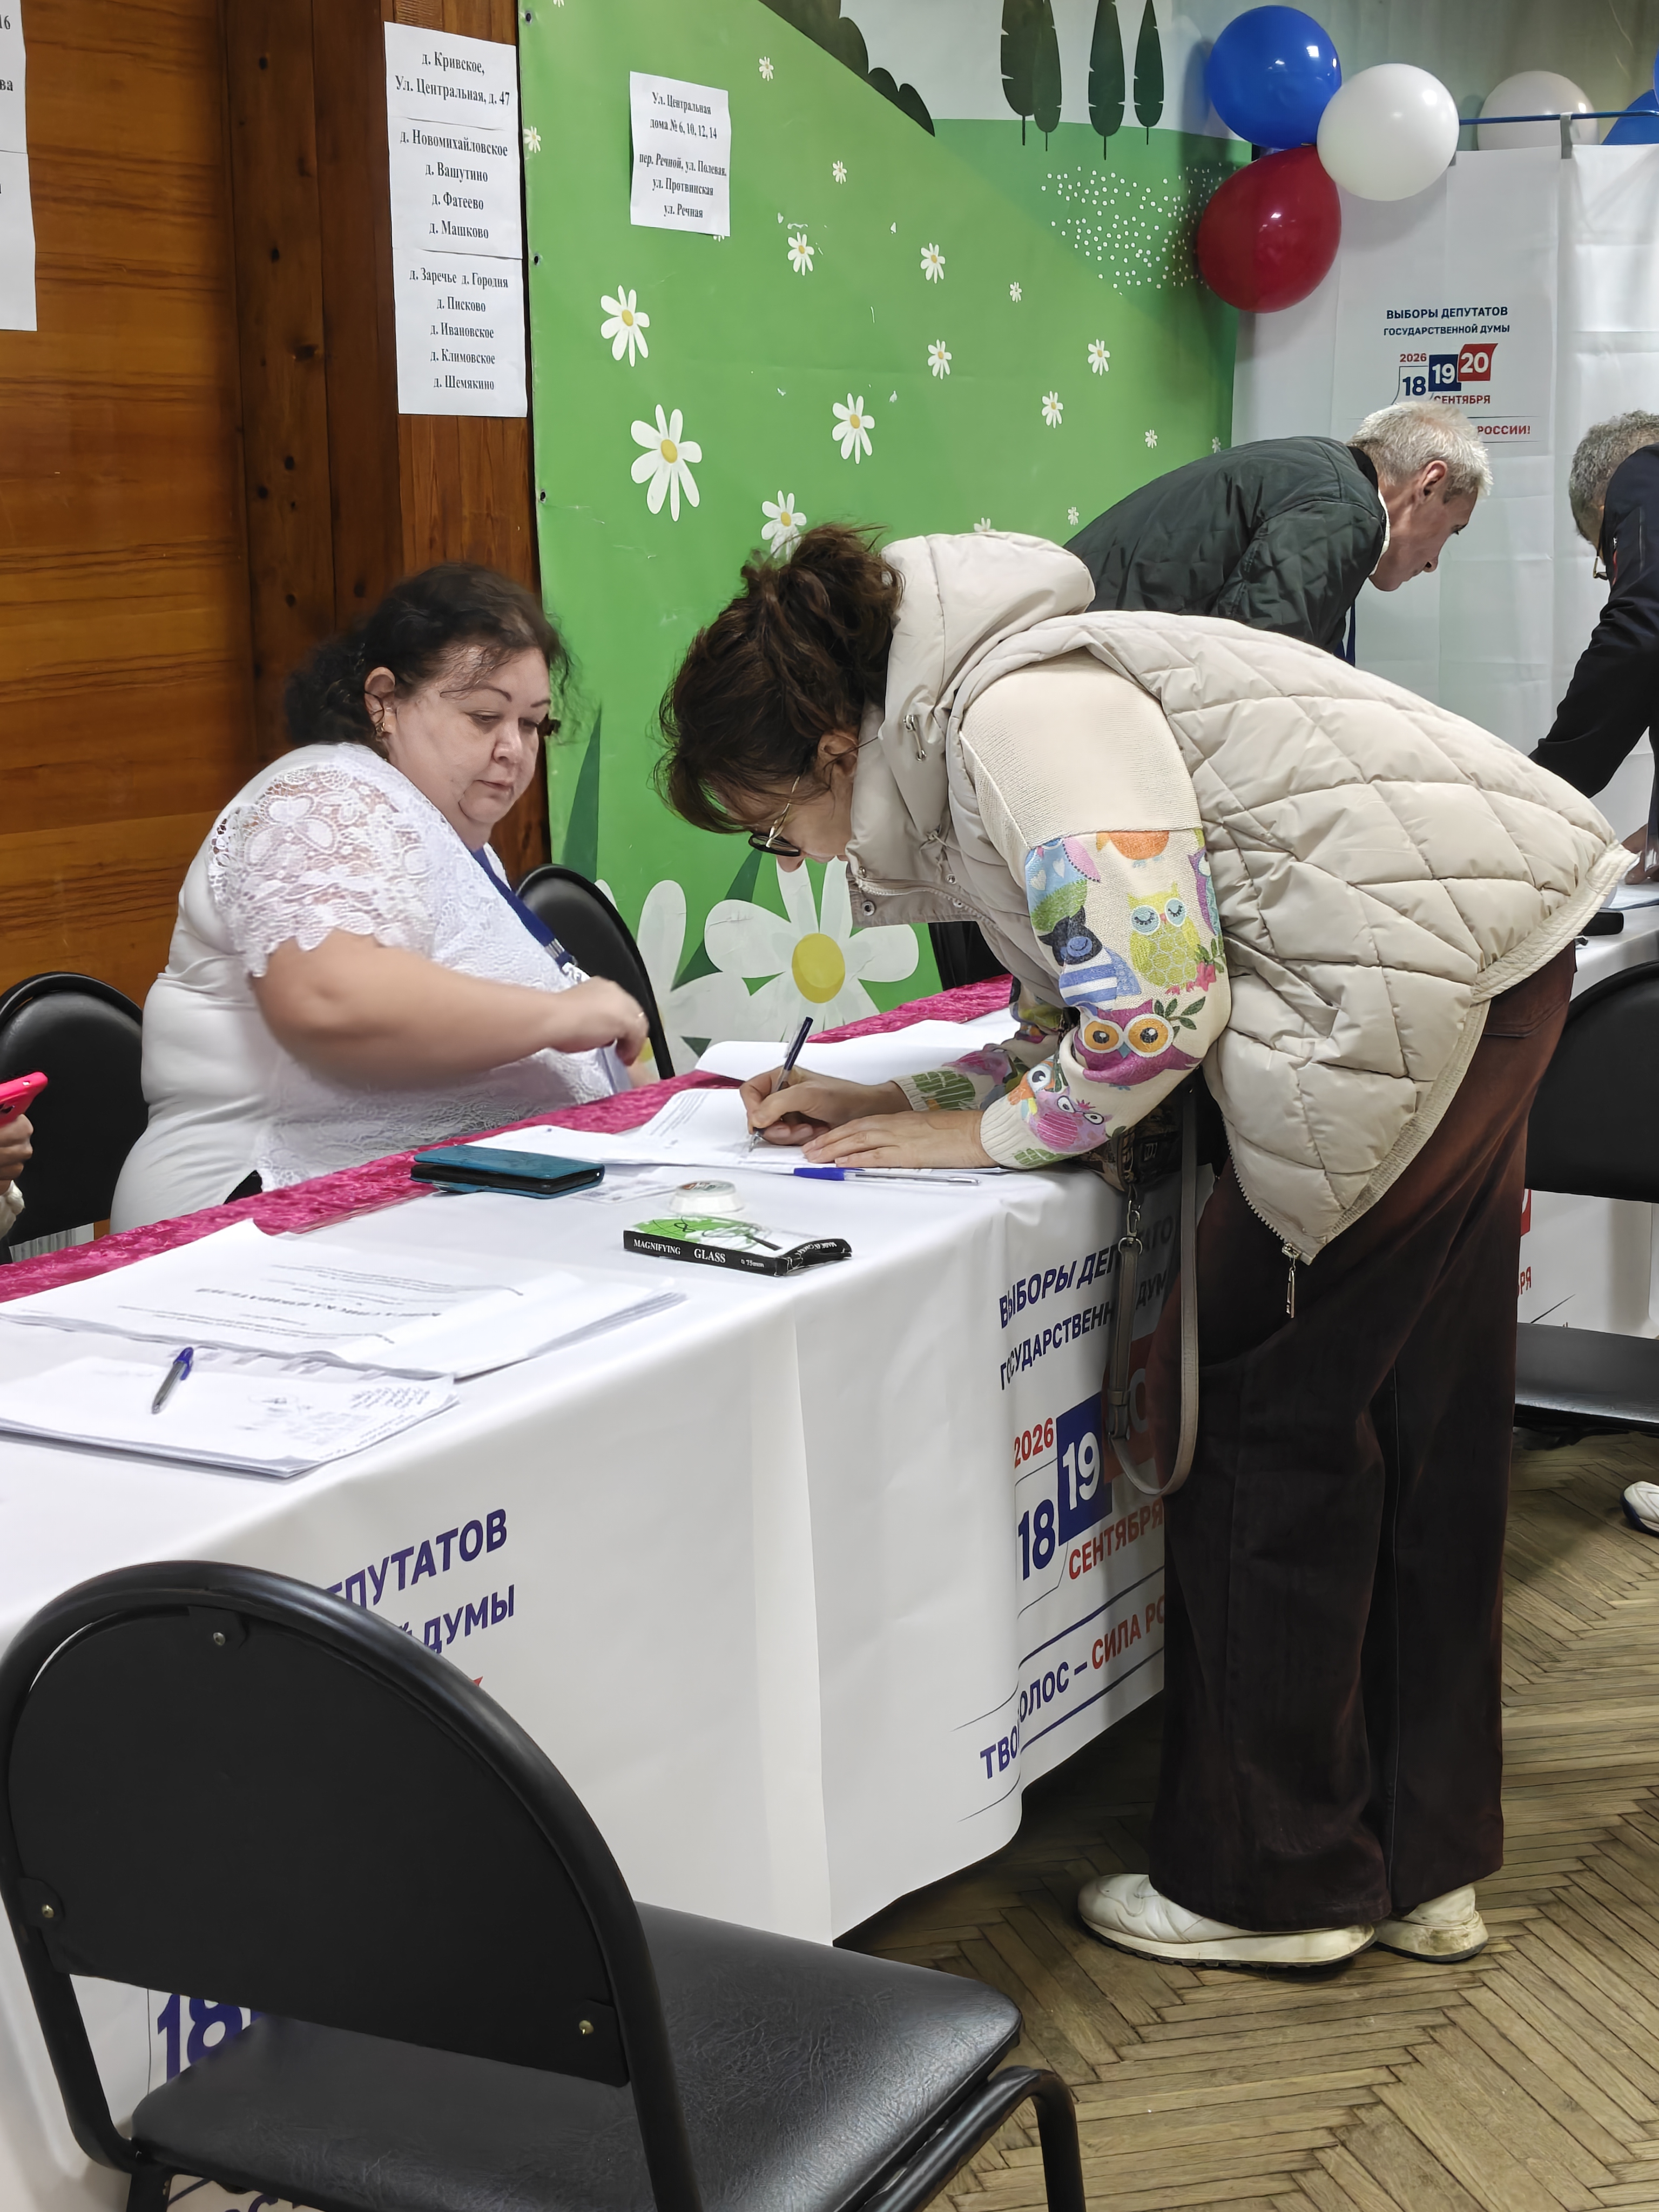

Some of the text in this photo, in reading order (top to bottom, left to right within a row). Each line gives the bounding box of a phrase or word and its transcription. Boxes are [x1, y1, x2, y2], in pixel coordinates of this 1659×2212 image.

[422, 51, 485, 76] д. Кривское,
[395, 75, 510, 106] Ул. Центральная, д. 47
[652, 91, 711, 114] Ул. Центральная
[650, 119, 668, 130] дома
[670, 119, 678, 132] №
[710, 127, 717, 139] 14
[400, 129, 508, 157] д. Новомихайловское
[425, 161, 488, 183] д. Вашутино
[639, 153, 653, 167] пер.
[685, 161, 696, 173] ул.
[652, 177, 713, 195] ул. Протвинская
[431, 192, 484, 210] д. Фатеево
[664, 203, 703, 218] ул. Речная
[429, 220, 489, 239] д. Машково
[409, 267, 508, 289] д. Заречье д. Городня
[436, 296, 485, 312] д. Писково
[1387, 306, 1508, 319] ВЫБОРЫ ДЕПУТАТОВ
[430, 322, 494, 339] д. Ивановское
[1384, 324, 1510, 336] ГОСУДАРСТВЕННОЙ ДУМЫ
[430, 348, 495, 365] д. Климовское
[1400, 353, 1427, 362] 2026
[433, 375, 494, 390] д. Шемякино
[1402, 352, 1489, 396] 18 19 20
[1478, 426, 1530, 435] РОССИИ!
[633, 1238, 726, 1263] MAGNIFYING GLASS
[1000, 1260, 1077, 1328] ВЫБОРЫ
[1000, 1269, 1168, 1390] ГОСУДАРСТВЕНН ДУМ
[1015, 1417, 1054, 1470] 2026
[1018, 1499, 1055, 1580] 18
[1062, 1432, 1100, 1511] 19
[1068, 1498, 1164, 1580] СЕНТЯБРЯ
[327, 1509, 507, 1609] ПУТАТОВ
[424, 1584, 514, 1654] ДУМЫ
[980, 1721, 1020, 1779] ТВО
[1019, 1661, 1069, 1723] ОЛОС
[1091, 1614, 1142, 1670] СИЛА
